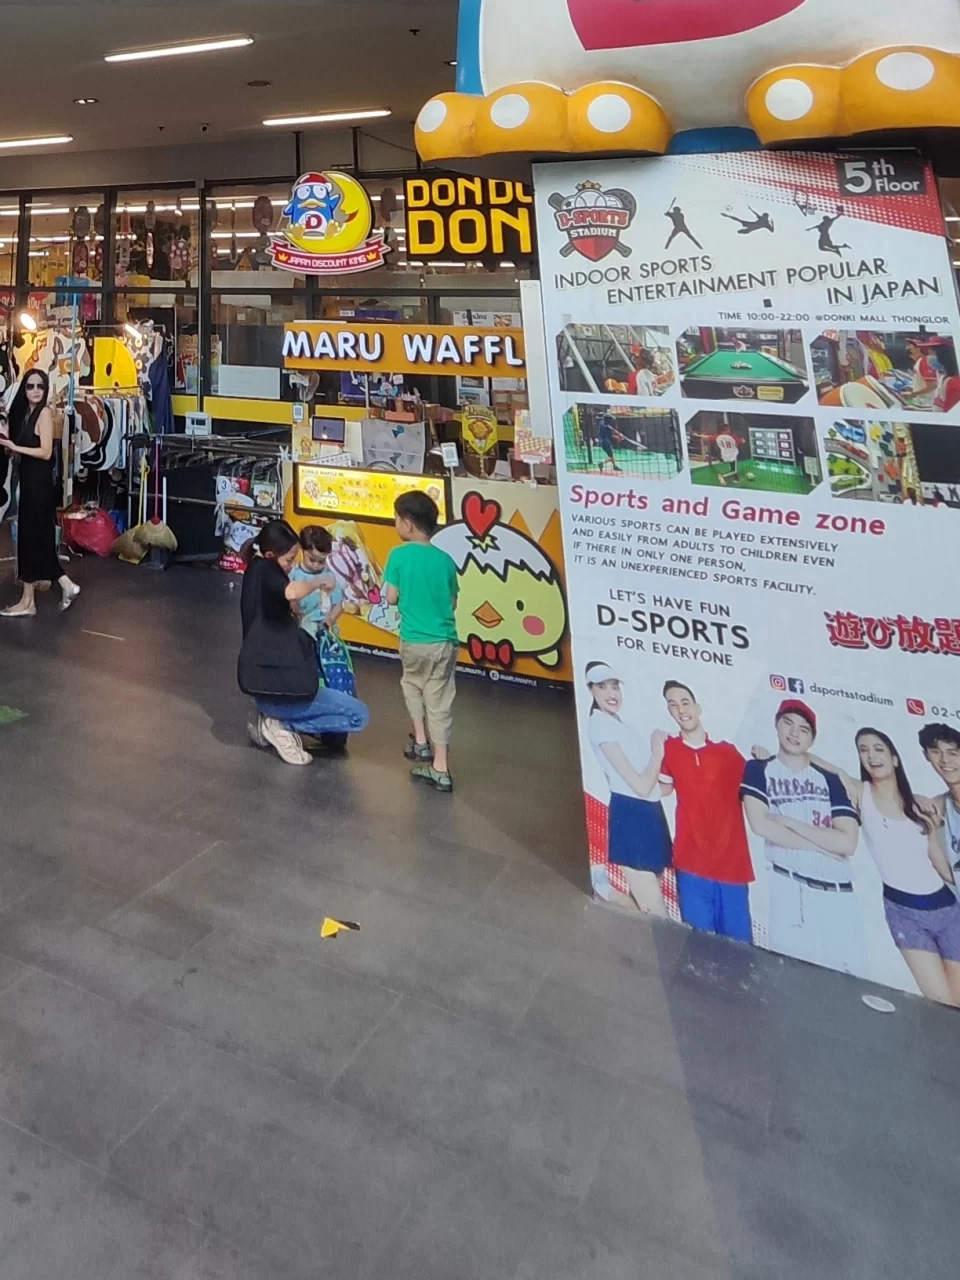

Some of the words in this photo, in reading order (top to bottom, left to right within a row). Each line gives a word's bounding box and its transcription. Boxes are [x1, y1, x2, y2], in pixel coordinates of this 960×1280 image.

[407, 177, 483, 207] DON
[875, 177, 920, 192] Floor
[408, 208, 532, 254] DON
[558, 210, 628, 228] D-SPORTS
[570, 228, 617, 238] STADIUM
[288, 255, 311, 266] JAPAN
[311, 258, 347, 268] DISCOUNT
[348, 255, 367, 265] KING
[554, 265, 632, 289] INDOOR
[640, 255, 713, 279] SPORTS
[607, 269, 777, 305] ENTERTAINMENT
[786, 258, 888, 285] POPULAR
[827, 286, 853, 305] IN
[861, 277, 940, 306] JAPAN
[718, 312, 742, 320] TIME
[747, 312, 810, 322] 10:00-22:00
[859, 315, 887, 323] MALL
[892, 315, 951, 325] THONGLOR
[282, 330, 382, 361] MARU
[403, 333, 524, 366] WAFFL
[570, 484, 648, 509] Sports
[661, 497, 709, 517] and
[722, 500, 800, 526] Game
[815, 513, 886, 535] zone
[571, 514, 617, 526] VARIOUS
[621, 519, 661, 532] SPORTS
[666, 524, 690, 535] CAN
[694, 528, 708, 537] BE
[712, 530, 755, 543] PLAYED
[760, 535, 839, 553] EXTENSIVELY
[571, 528, 594, 537] AND
[598, 530, 633, 543] EASILY
[637, 535, 668, 547] FROM
[672, 540, 715, 553] ADULTS
[720, 545, 735, 555] TO
[740, 547, 798, 563] CHILDREN
[803, 555, 835, 568] EVEN
[573, 541, 582, 549] IF
[586, 542, 617, 554] THERE
[621, 547, 632, 556] IN
[636, 549, 670, 562] ONLY
[670, 554, 693, 564] ONE
[697, 557, 746, 572] PERSON,
[574, 555, 584, 563] IT
[587, 557, 597, 565] IS
[601, 559, 616, 568] AN
[621, 561, 708, 580] UNEXPERIENCED
[713, 573, 758, 587] SPORTS
[763, 580, 816, 596] FACILITY.
[609, 588, 646, 604] LET'S
[653, 595, 693, 612] HAVE
[700, 602, 731, 618] FUN
[597, 604, 750, 650] D-SPORTS
[616, 636, 646, 652] FOR
[652, 642, 734, 666] EVERYONE
[809, 683, 894, 707] dsportsstadium
